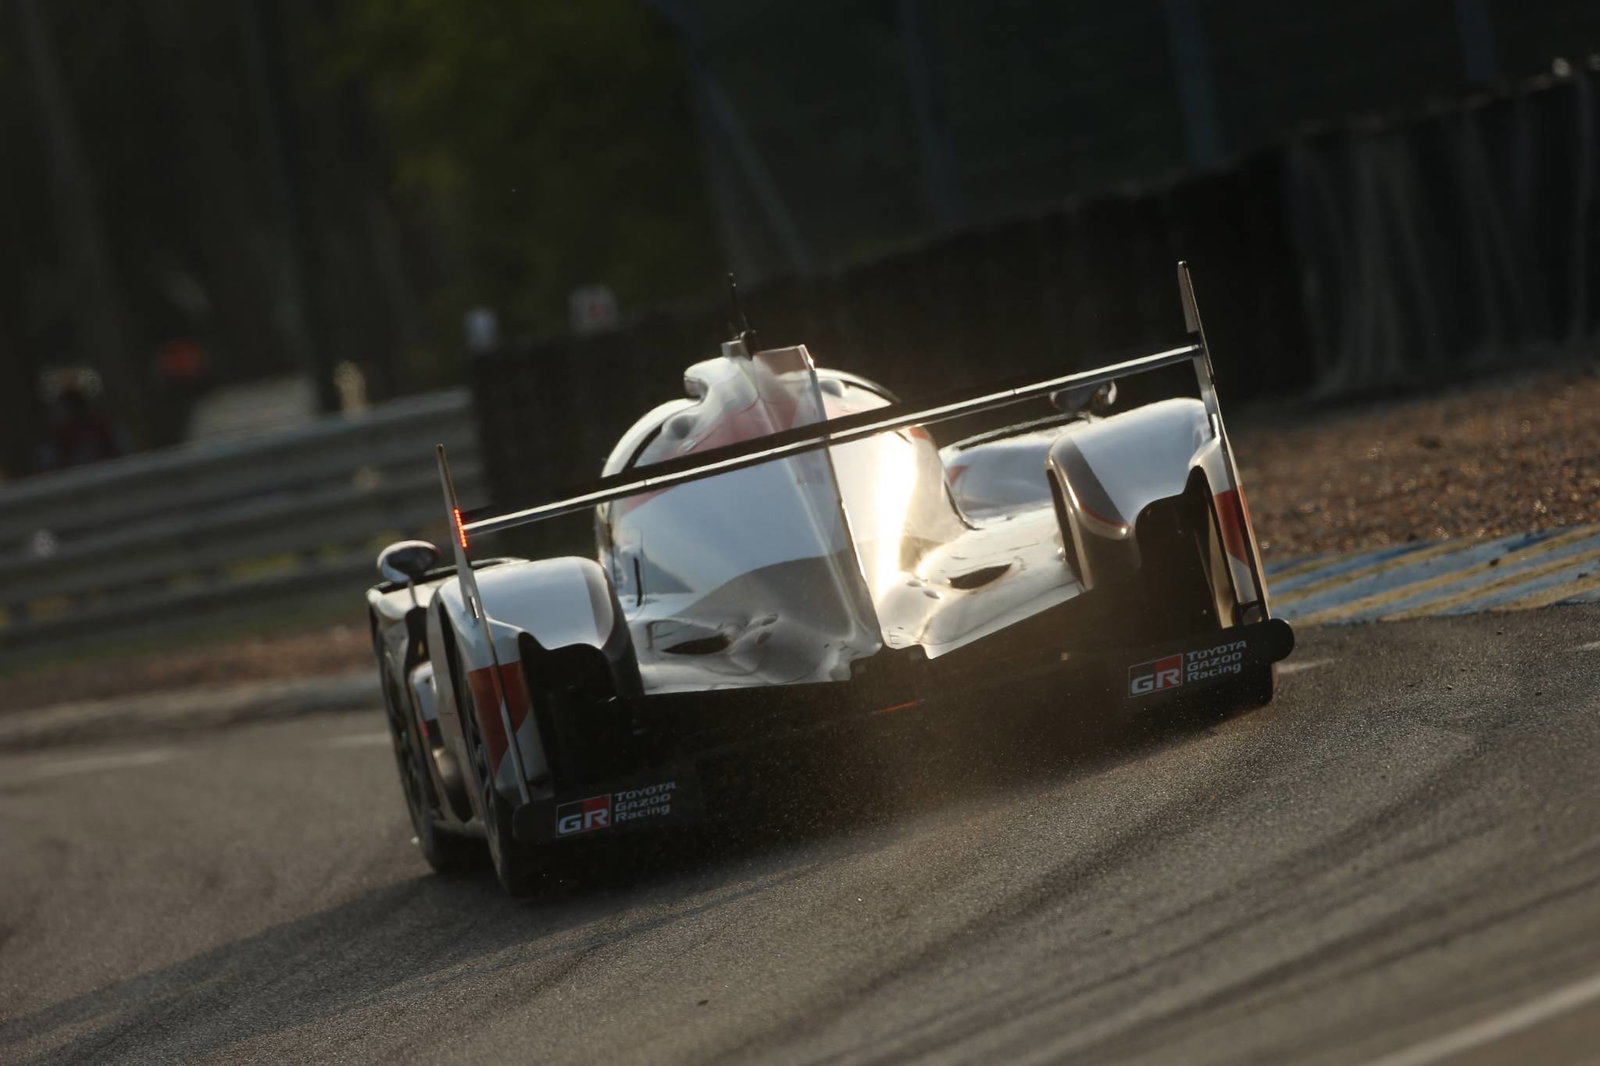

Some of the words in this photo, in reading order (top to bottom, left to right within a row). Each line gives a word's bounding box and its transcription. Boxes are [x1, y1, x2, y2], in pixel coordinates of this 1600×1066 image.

[1186, 640, 1247, 661] TOYOTA
[1187, 652, 1242, 671] GAZOO
[1131, 668, 1180, 694] GR
[1187, 663, 1241, 682] Racing
[614, 781, 676, 801] TOYOTA
[615, 793, 671, 812] GAZOO
[558, 808, 608, 834] GR
[615, 804, 670, 822] Racing
